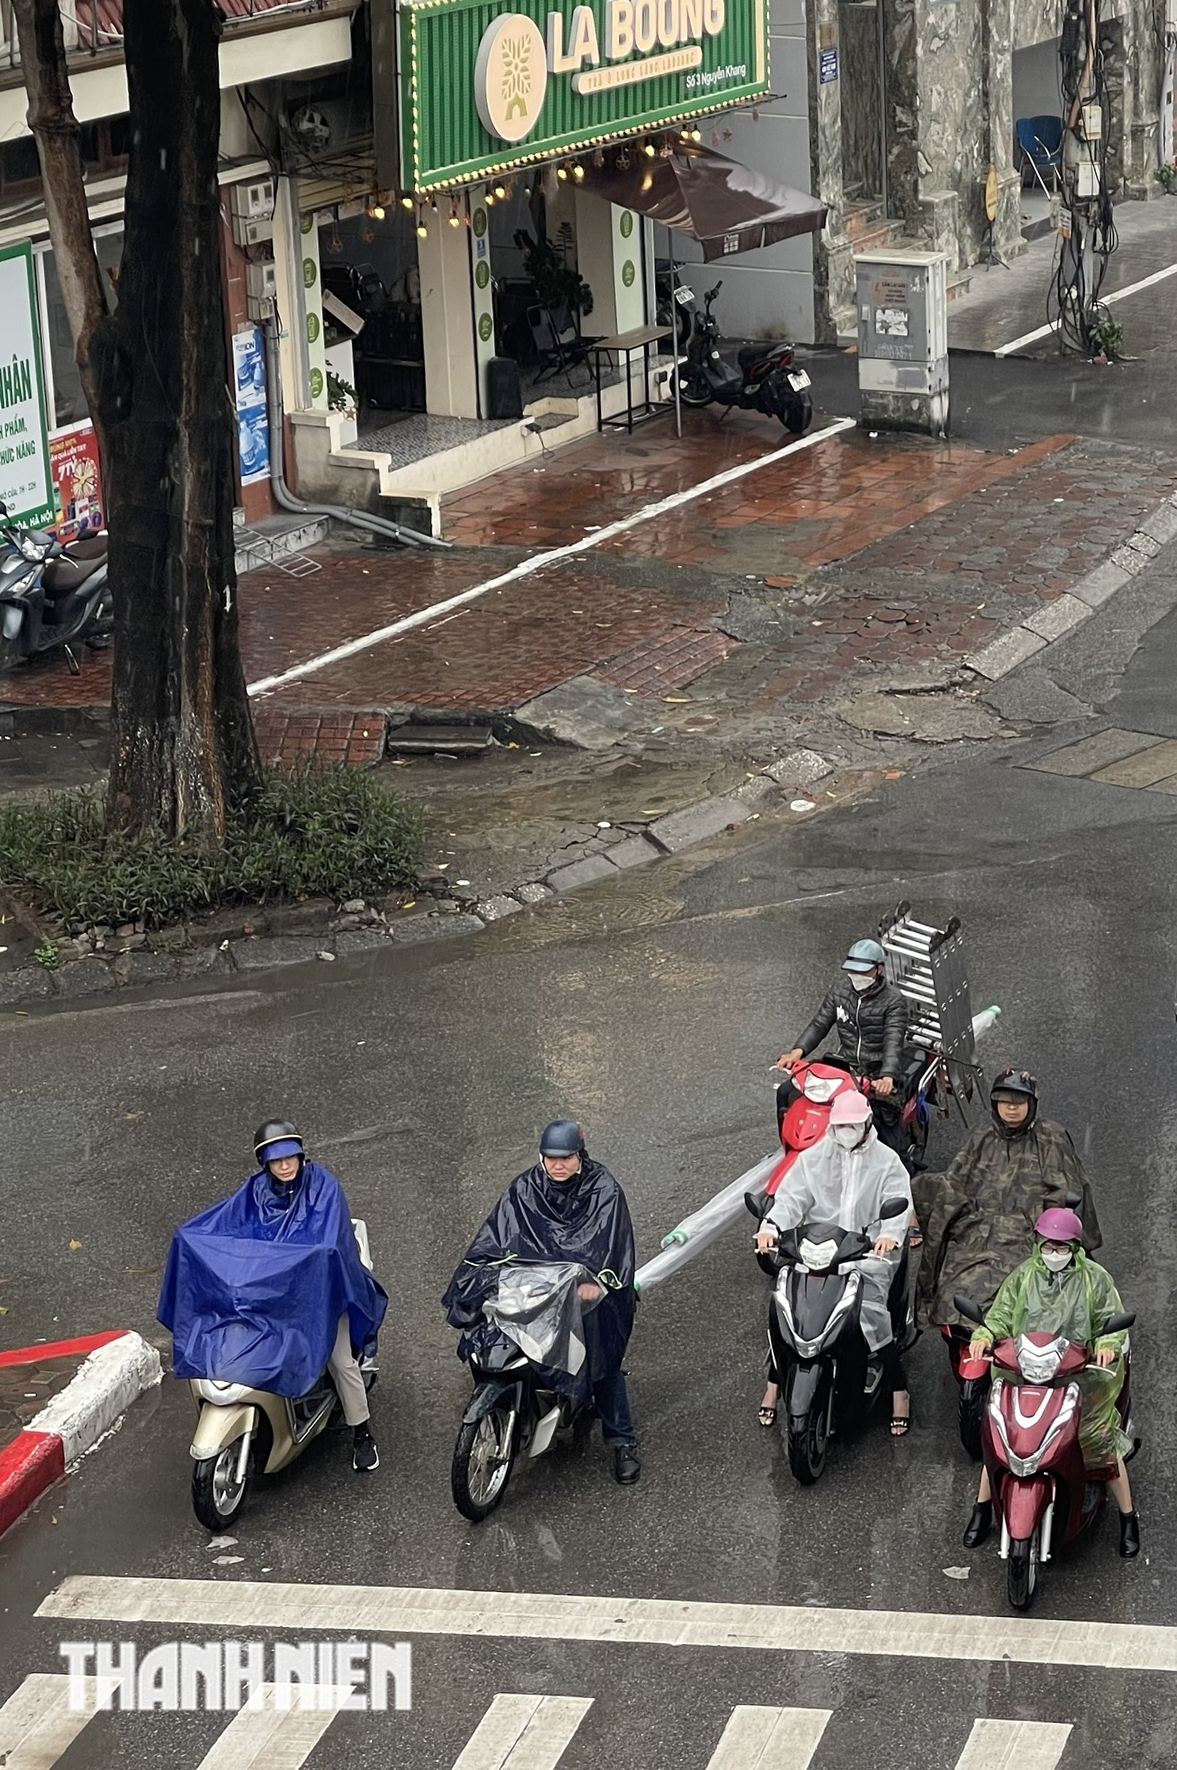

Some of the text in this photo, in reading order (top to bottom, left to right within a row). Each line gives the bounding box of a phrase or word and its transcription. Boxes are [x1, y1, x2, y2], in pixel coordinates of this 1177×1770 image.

[548, 5, 600, 73] LA
[686, 73, 696, 88] Số
[696, 73, 701, 86] 3
[725, 64, 746, 77] Khang
[15, 440, 36, 460] NĂNG
